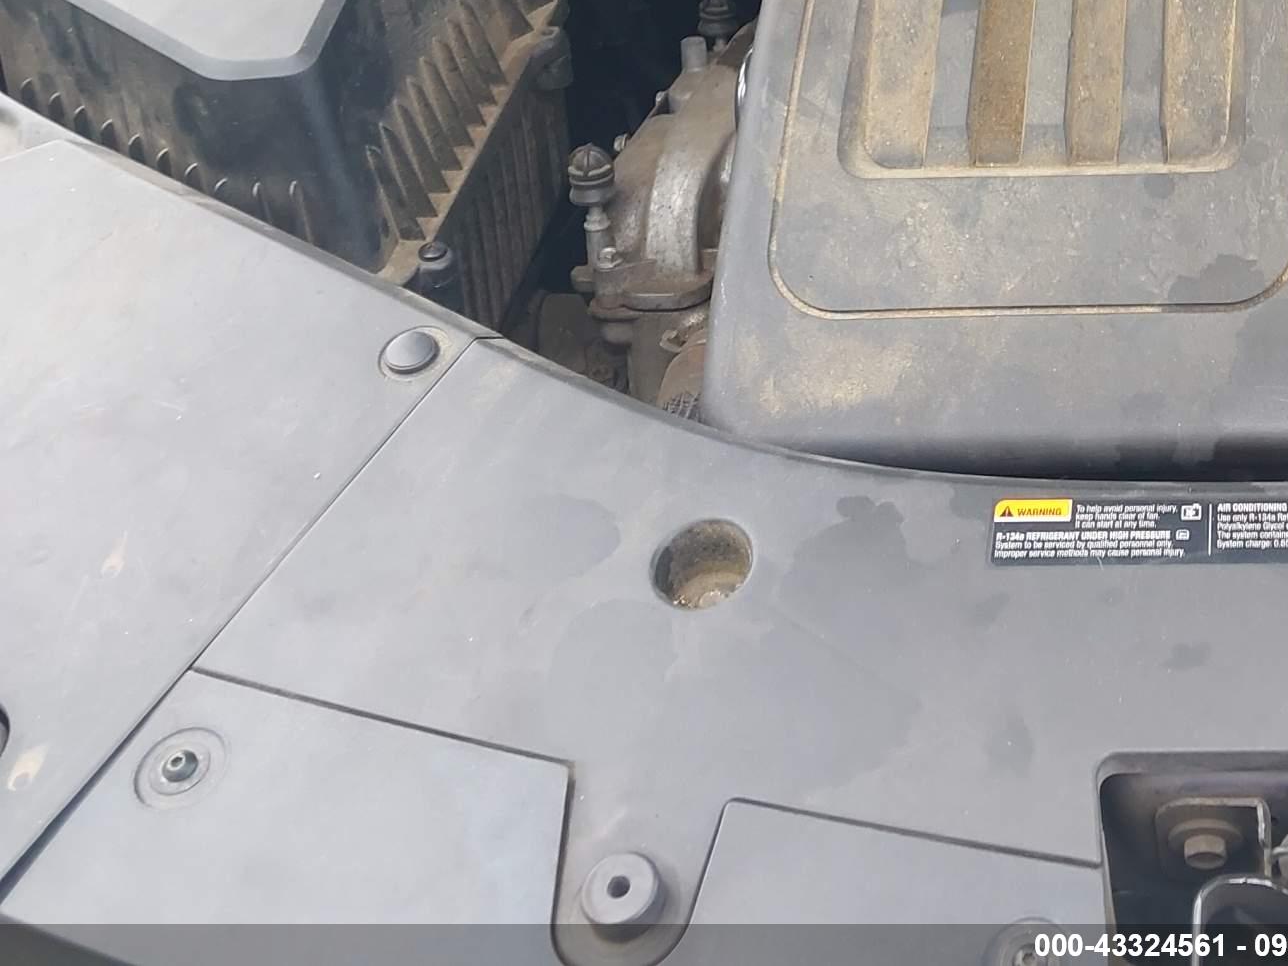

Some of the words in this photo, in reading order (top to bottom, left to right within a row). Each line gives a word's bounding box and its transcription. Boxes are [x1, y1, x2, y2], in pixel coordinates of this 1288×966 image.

[1217, 502, 1231, 512] AIR
[1232, 502, 1288, 512] CONDITIONING
[1017, 508, 1063, 516] WARNING
